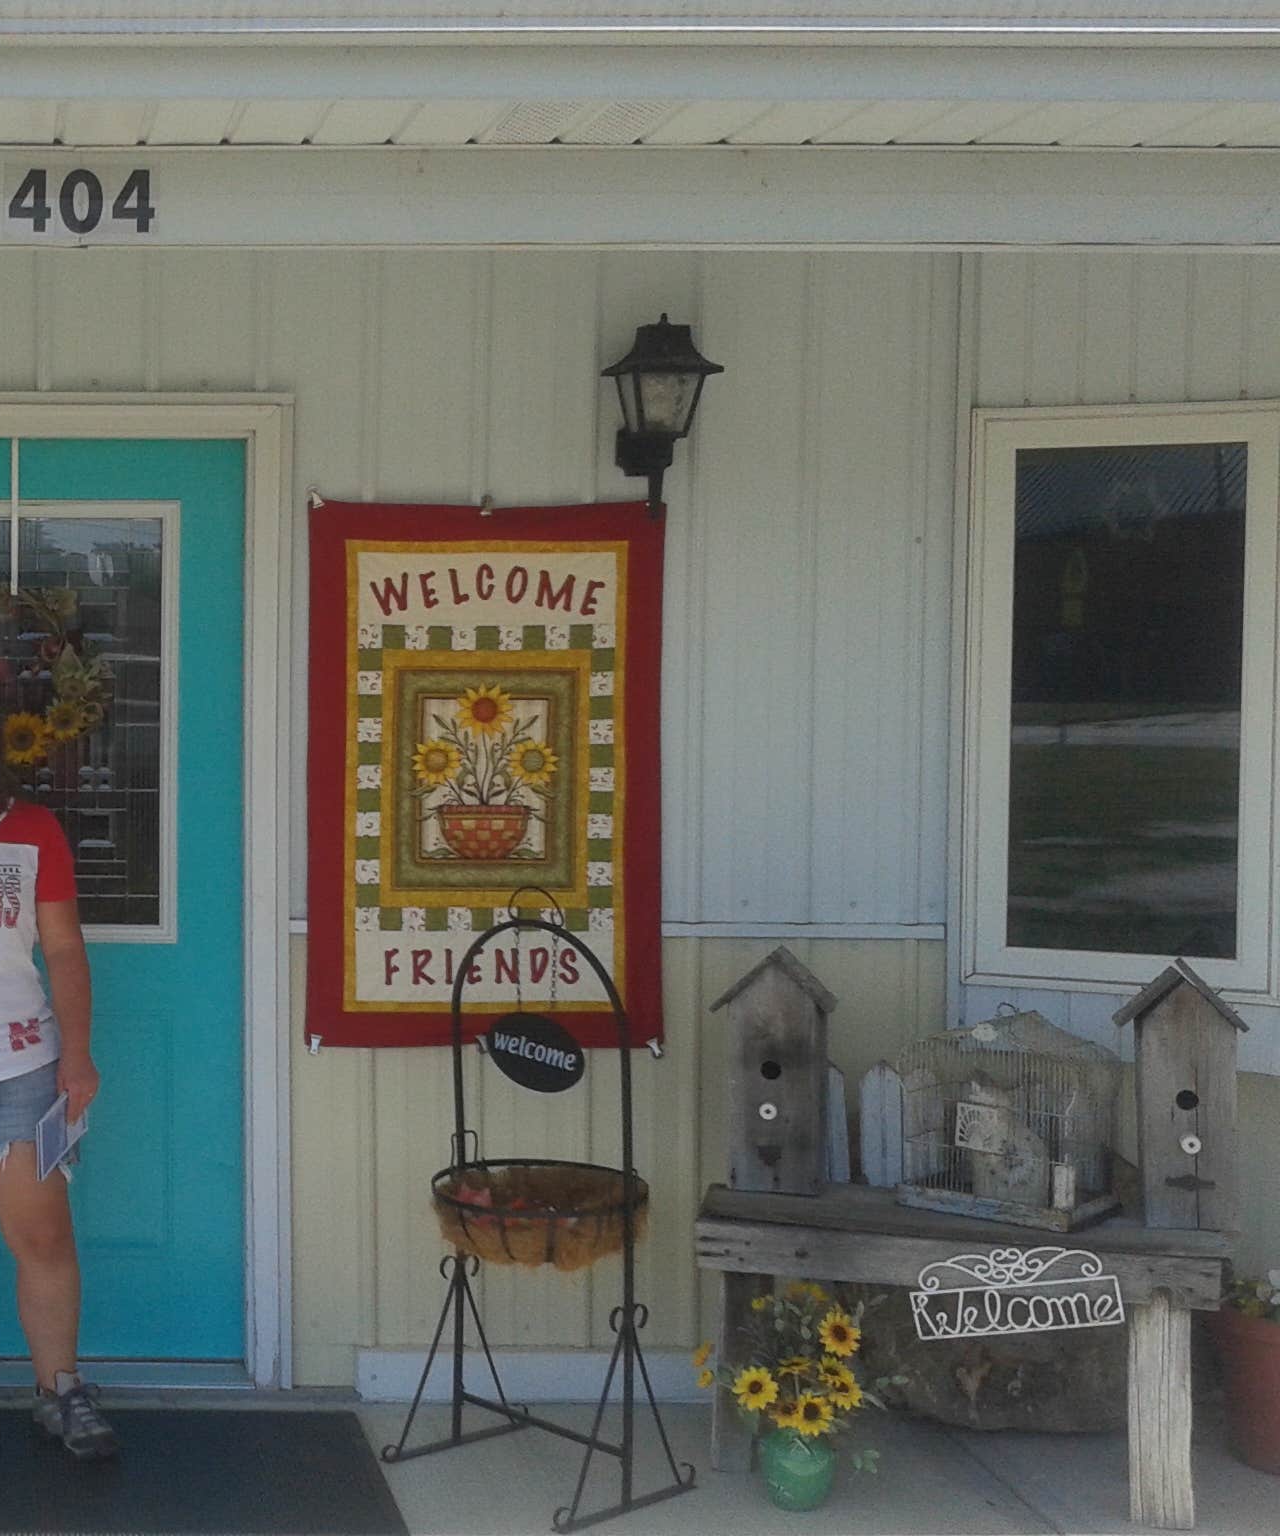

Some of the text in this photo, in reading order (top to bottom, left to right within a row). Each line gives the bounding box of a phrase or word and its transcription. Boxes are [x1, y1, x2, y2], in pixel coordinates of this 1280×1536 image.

[9, 168, 155, 234] 404
[369, 563, 606, 616] WELCOME
[384, 947, 581, 985] FRIENDS
[8, 1018, 42, 1051] N
[493, 1031, 577, 1071] welcome
[913, 1289, 1122, 1336] Welcome
